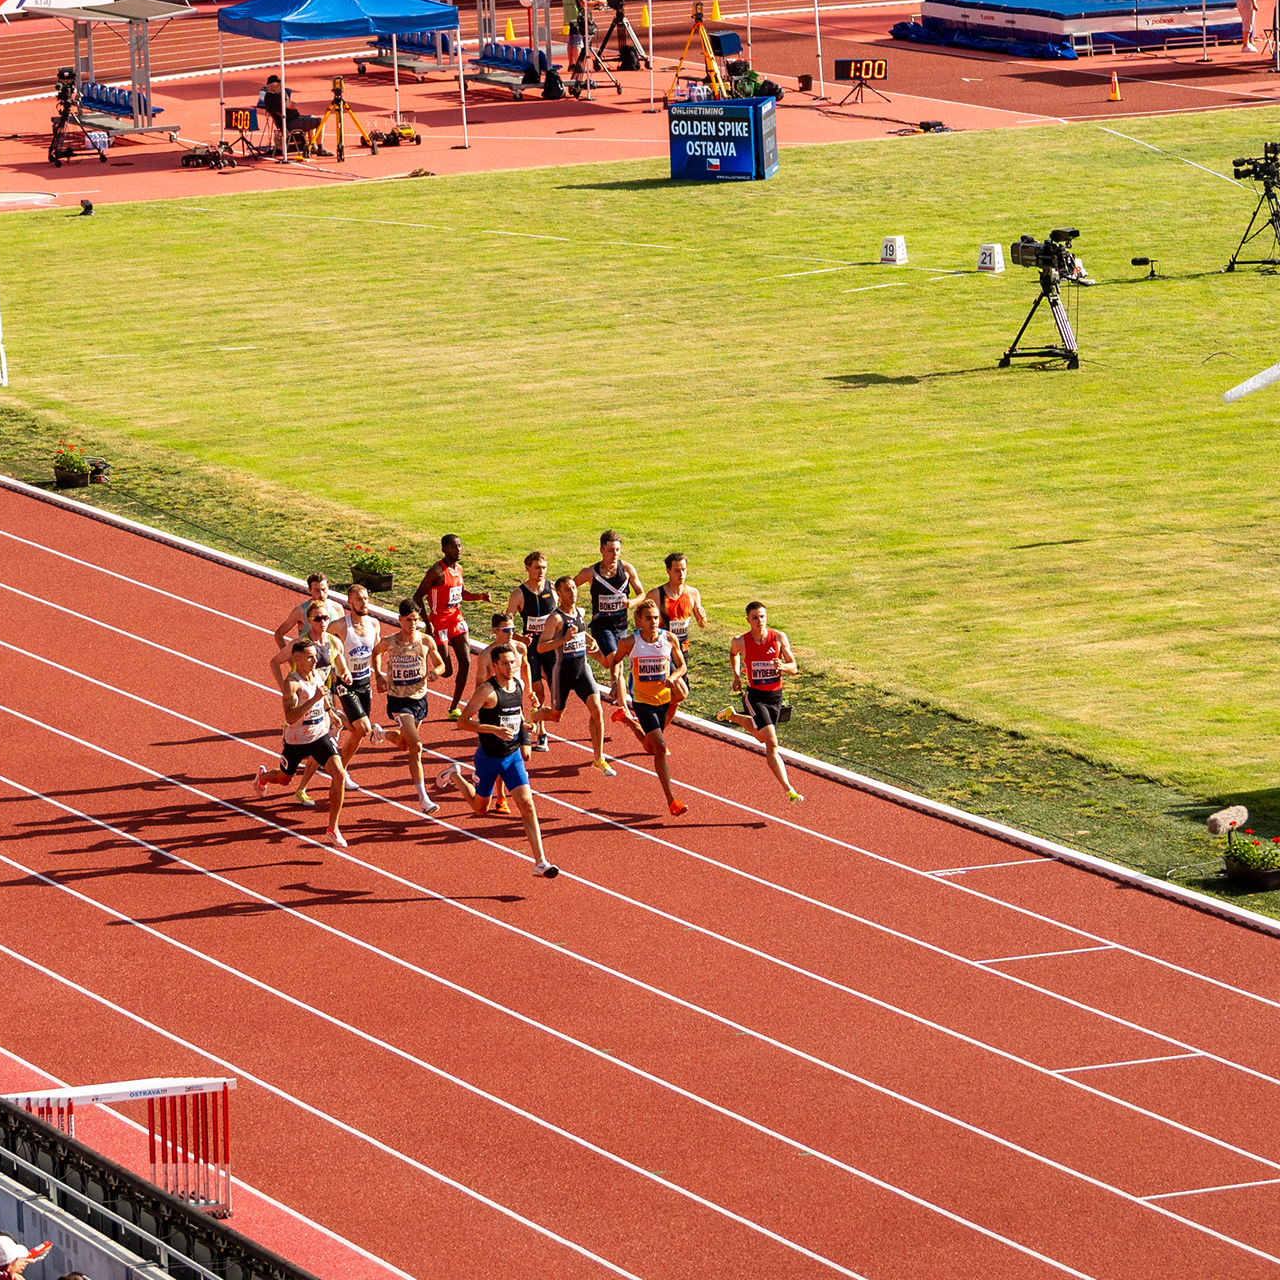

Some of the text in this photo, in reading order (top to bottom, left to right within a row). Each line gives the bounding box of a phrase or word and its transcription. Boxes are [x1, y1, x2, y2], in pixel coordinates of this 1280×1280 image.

[850, 60, 886, 79] 1:00
[671, 106, 724, 116] ONLINETIMING
[231, 110, 250, 130] 1:00
[671, 119, 716, 136] GOLDEN
[718, 121, 749, 137] SPIKE
[686, 140, 737, 157] OSTRAVA
[883, 244, 895, 257] 19
[980, 251, 992, 265] 21
[393, 670, 402, 679] LE
